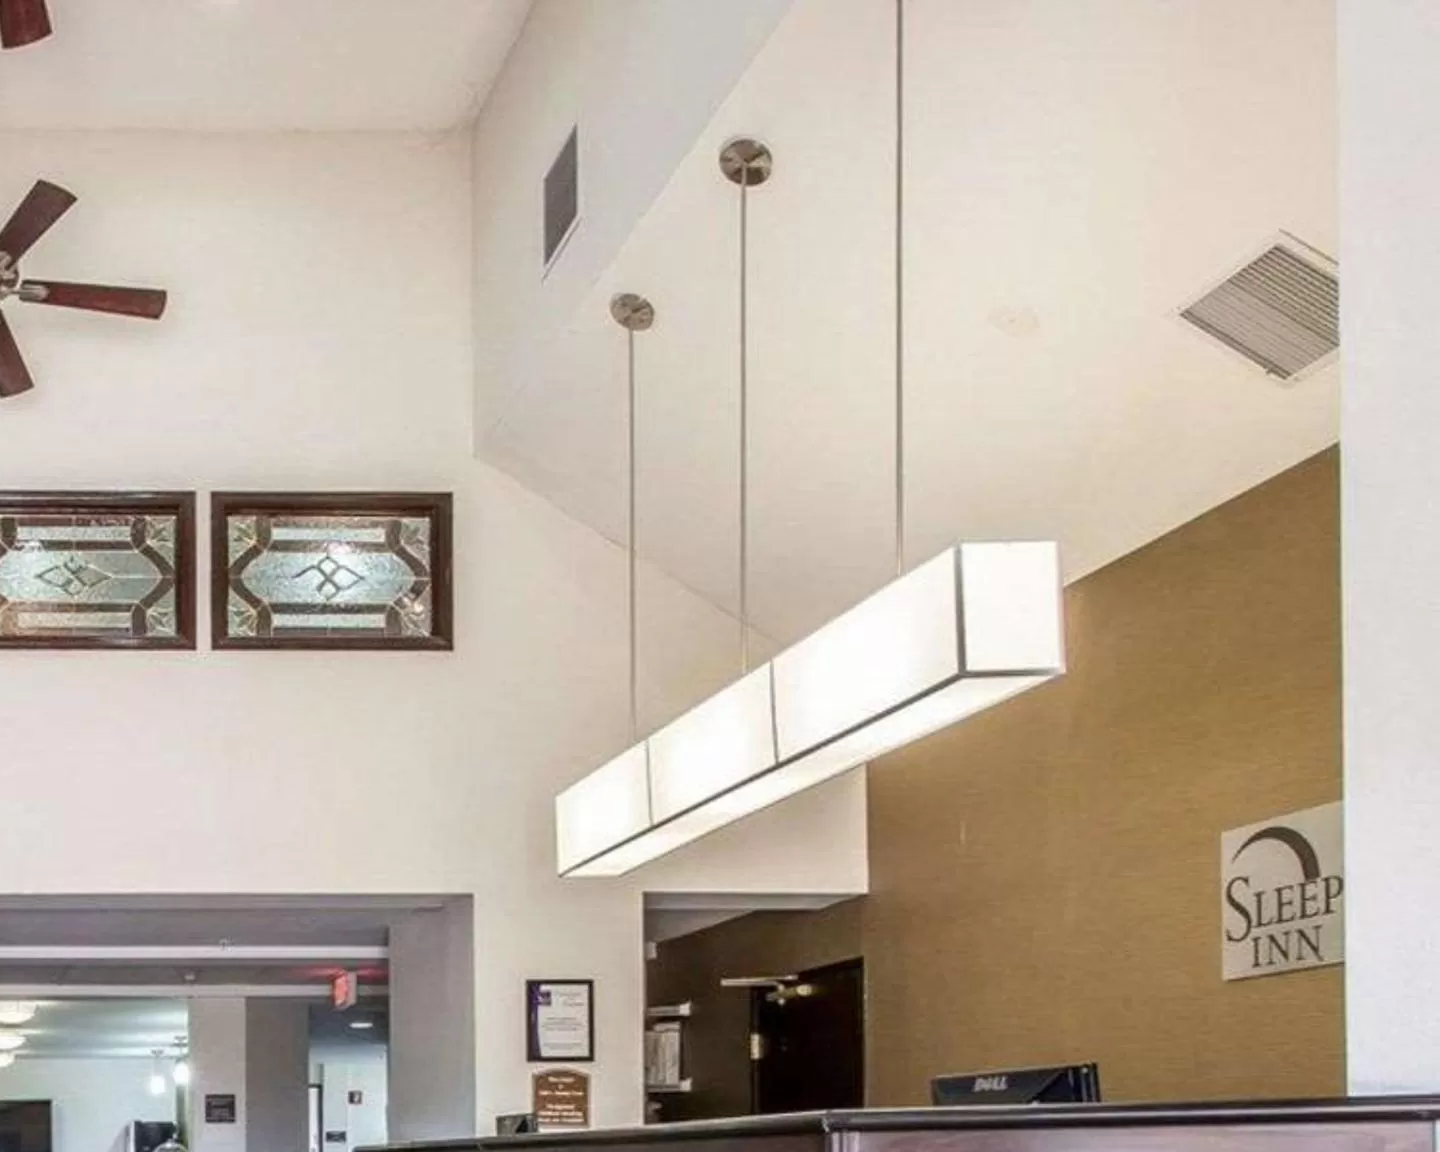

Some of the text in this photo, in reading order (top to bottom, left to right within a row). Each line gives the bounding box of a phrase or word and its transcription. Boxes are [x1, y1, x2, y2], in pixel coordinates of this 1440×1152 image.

[1225, 875, 1344, 942] SLEEP
[1252, 925, 1324, 968] INN
[973, 1076, 1009, 1093] DELL
